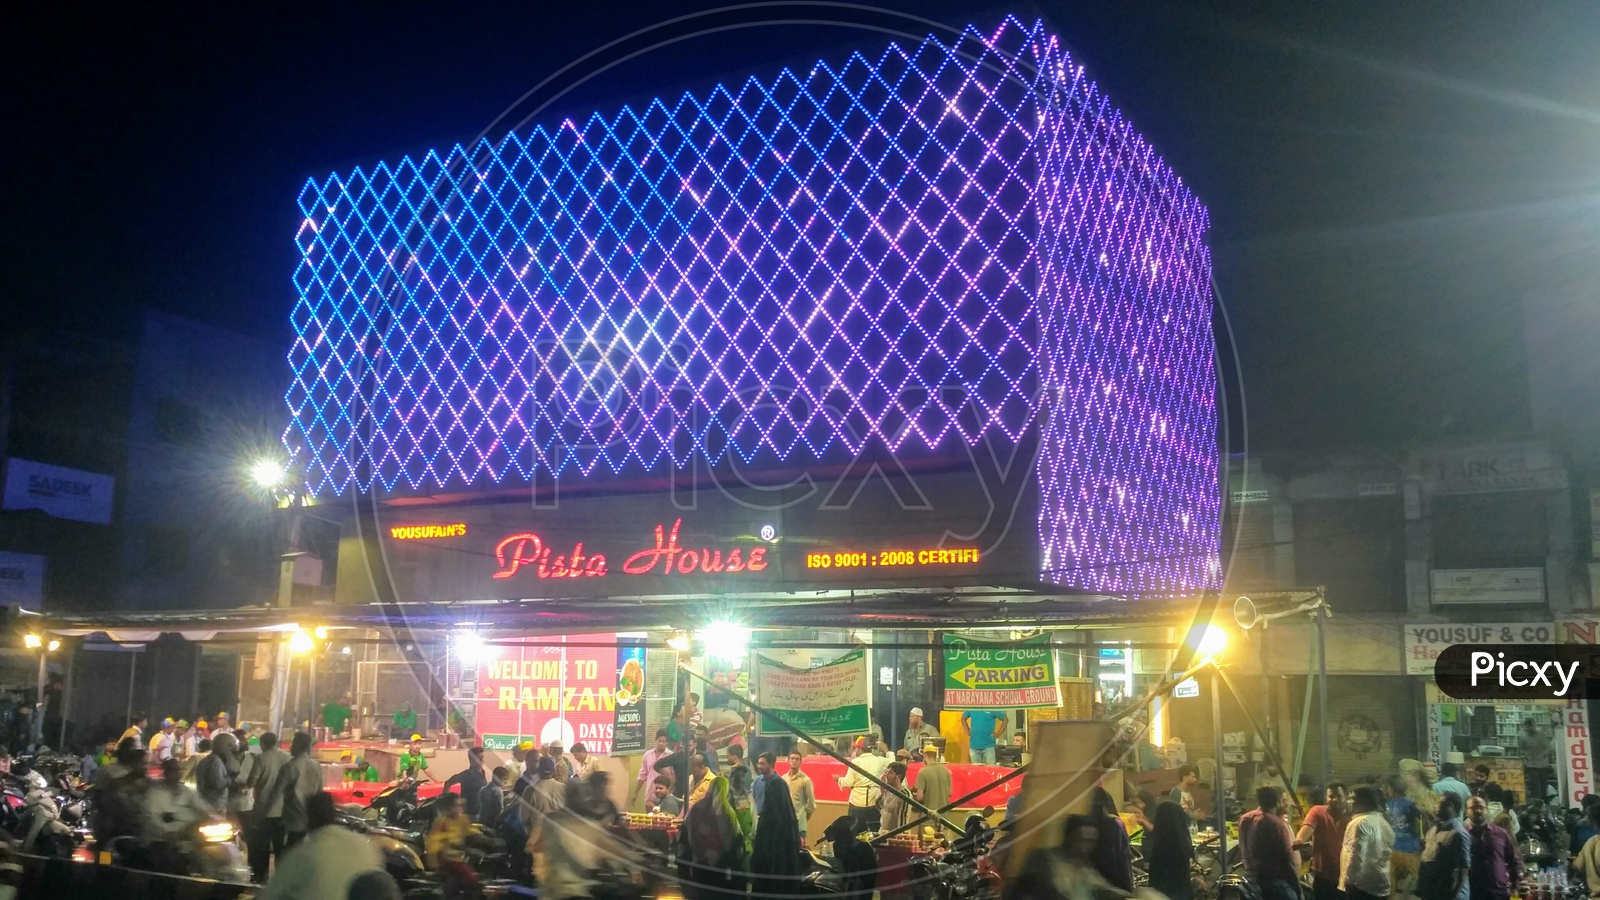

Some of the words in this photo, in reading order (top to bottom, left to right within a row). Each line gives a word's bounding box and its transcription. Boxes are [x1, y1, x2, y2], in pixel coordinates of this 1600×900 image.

[493, 533, 608, 580] Pista
[623, 517, 768, 576] House
[807, 554, 831, 568] ISO
[834, 553, 867, 567] 9001
[880, 551, 915, 566] 2008
[918, 549, 978, 564] CERTIFI
[1413, 627, 1493, 643] YOUSUF
[1500, 626, 1514, 642] &
[948, 639, 991, 661] Pista
[995, 641, 1047, 662] House
[487, 660, 568, 680] WELCOME
[575, 660, 598, 680] TO
[964, 666, 1045, 683] PARKING
[498, 686, 616, 712] RAMZAN
[945, 691, 955, 704] AT
[956, 691, 994, 704] NARAYANA
[995, 690, 1024, 704] SCHOOL
[1025, 688, 1057, 703] GROUND
[810, 710, 852, 724] House
[579, 723, 614, 739] DAYS
[484, 738, 505, 750] Pista
[1566, 694, 1590, 803] Hamdard
